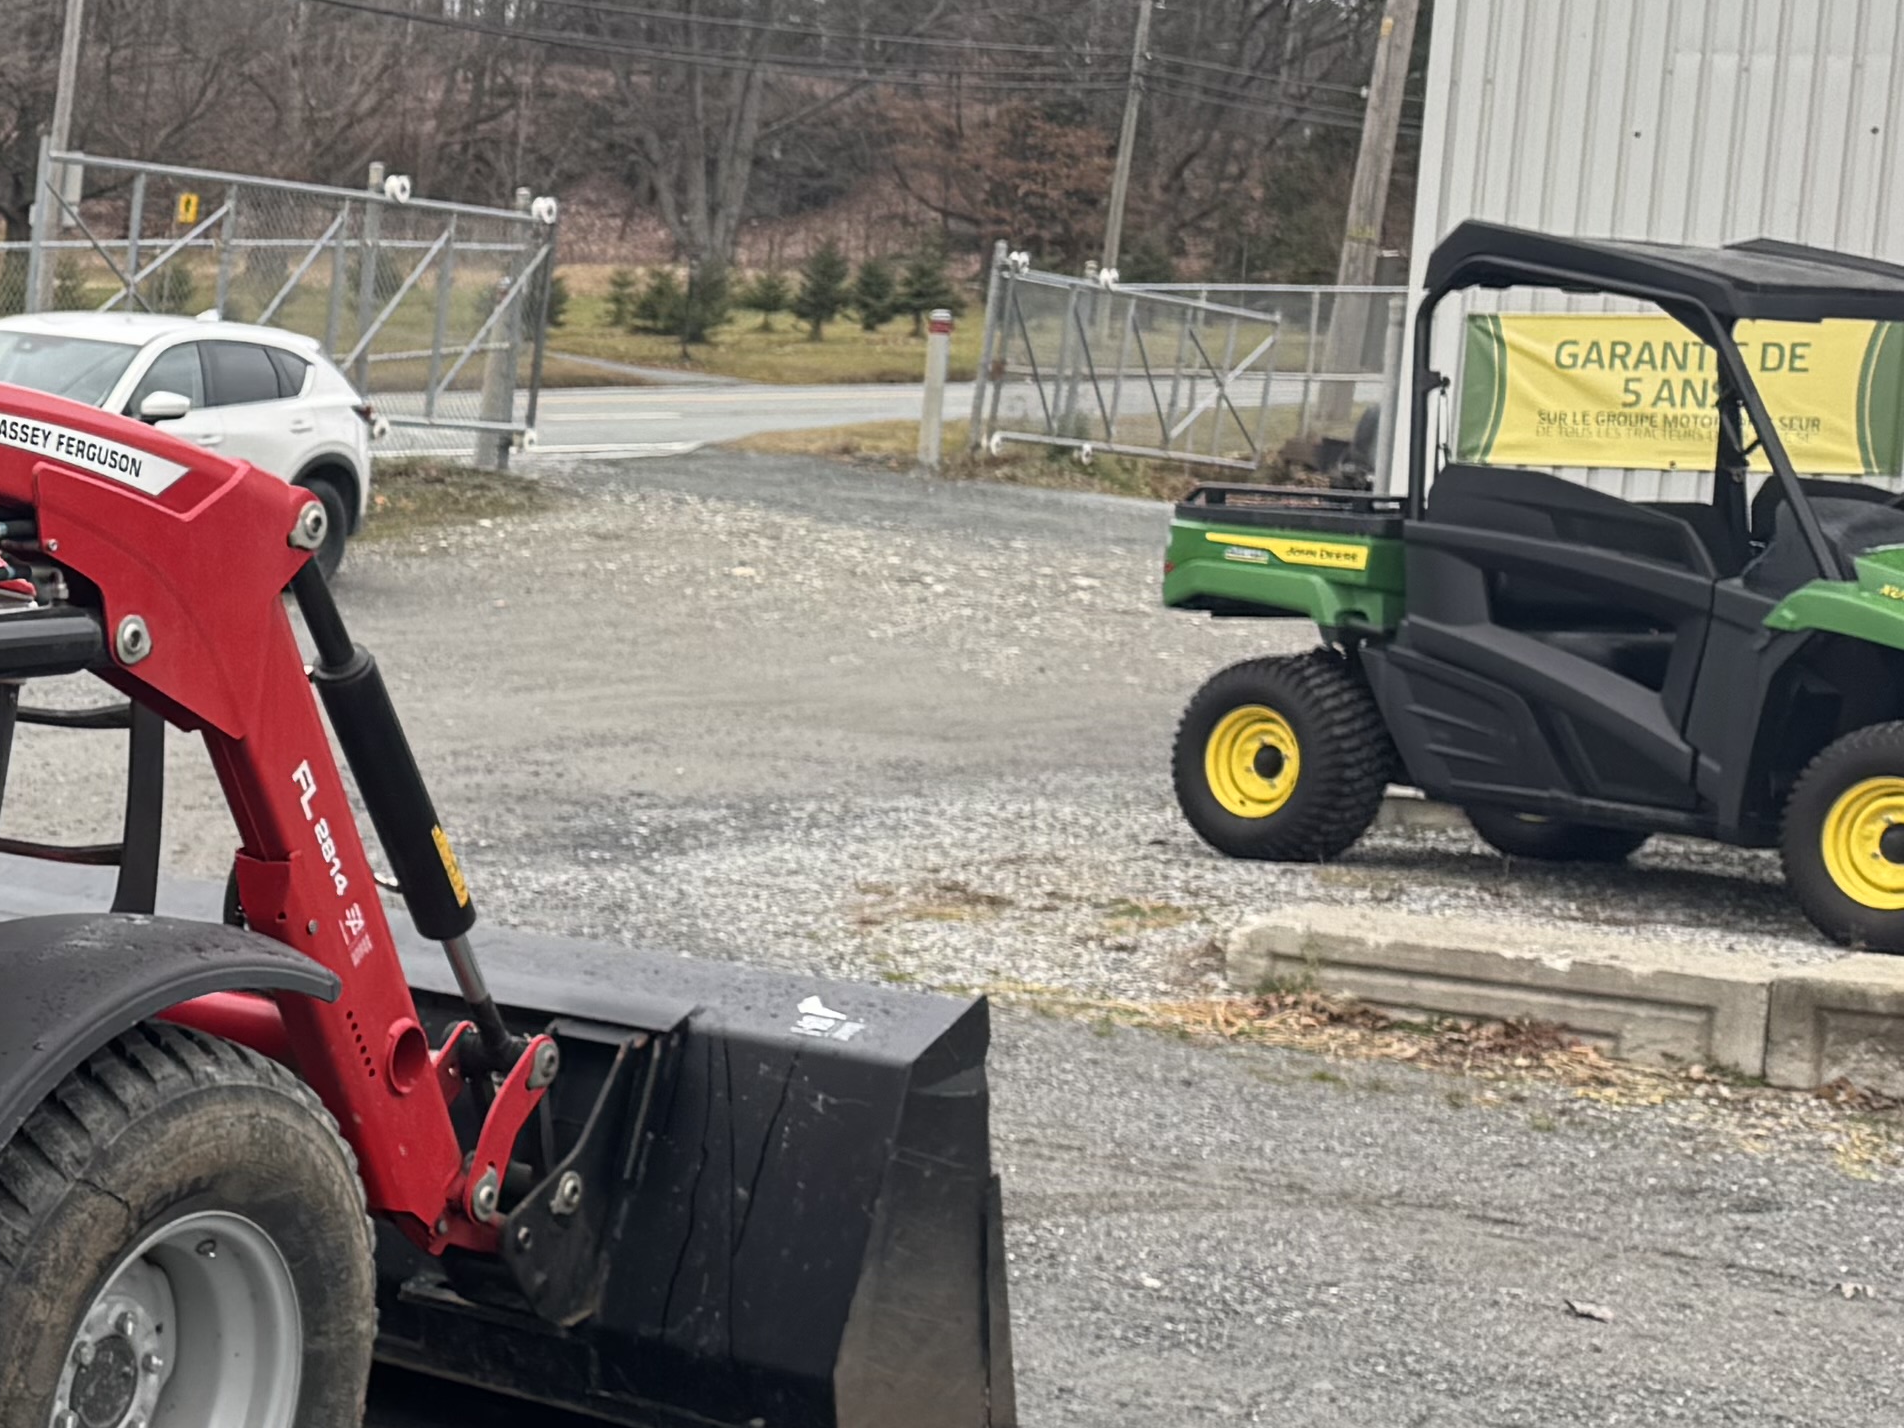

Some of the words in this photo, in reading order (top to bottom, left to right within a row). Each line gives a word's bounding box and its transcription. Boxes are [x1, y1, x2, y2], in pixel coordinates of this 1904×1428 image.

[1554, 339, 1749, 372] GARANT
[1759, 342, 1811, 372] DE
[1621, 377, 1642, 408] 5
[1537, 410, 1568, 426] SUR
[1572, 410, 1591, 426] LE
[56, 434, 142, 477] FERGUSON
[314, 818, 349, 897] 2814
